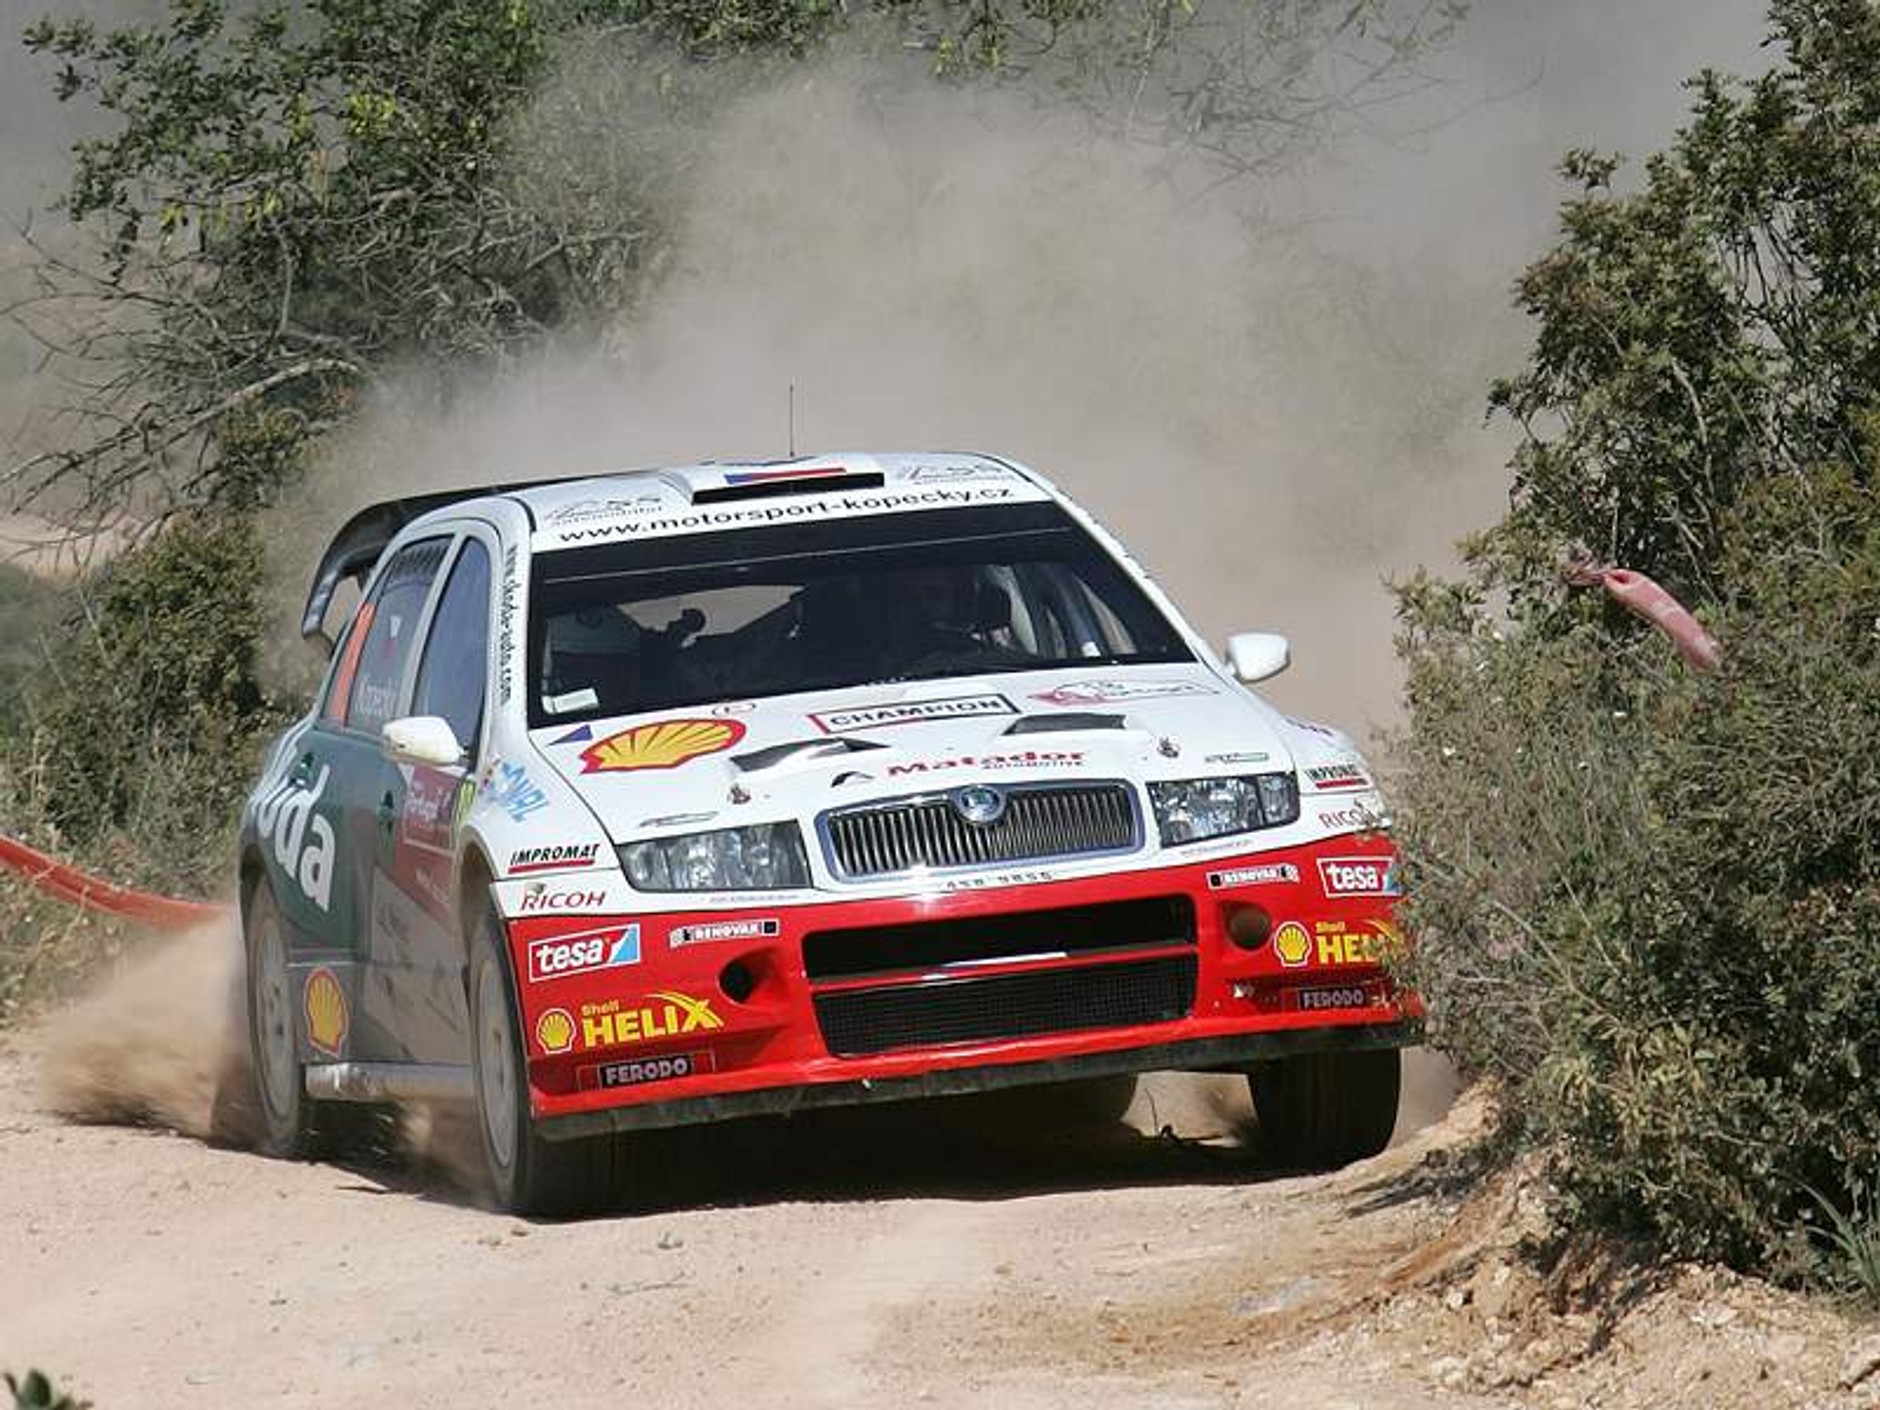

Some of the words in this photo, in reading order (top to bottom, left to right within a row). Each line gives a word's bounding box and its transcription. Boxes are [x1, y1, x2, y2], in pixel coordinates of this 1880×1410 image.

[560, 488, 1013, 542] www.motorsport-kopecky.cz
[830, 698, 1002, 727] CHAMPION
[888, 750, 1087, 777] Matador
[510, 843, 600, 865] IMPROMAT
[1326, 863, 1379, 890] tesa
[520, 890, 605, 911] RICOH
[535, 939, 604, 973] tesa
[581, 999, 620, 1016] Shell
[1303, 989, 1364, 1009] FERODO
[582, 990, 725, 1048] HELIX
[604, 1057, 689, 1086] FERODO
